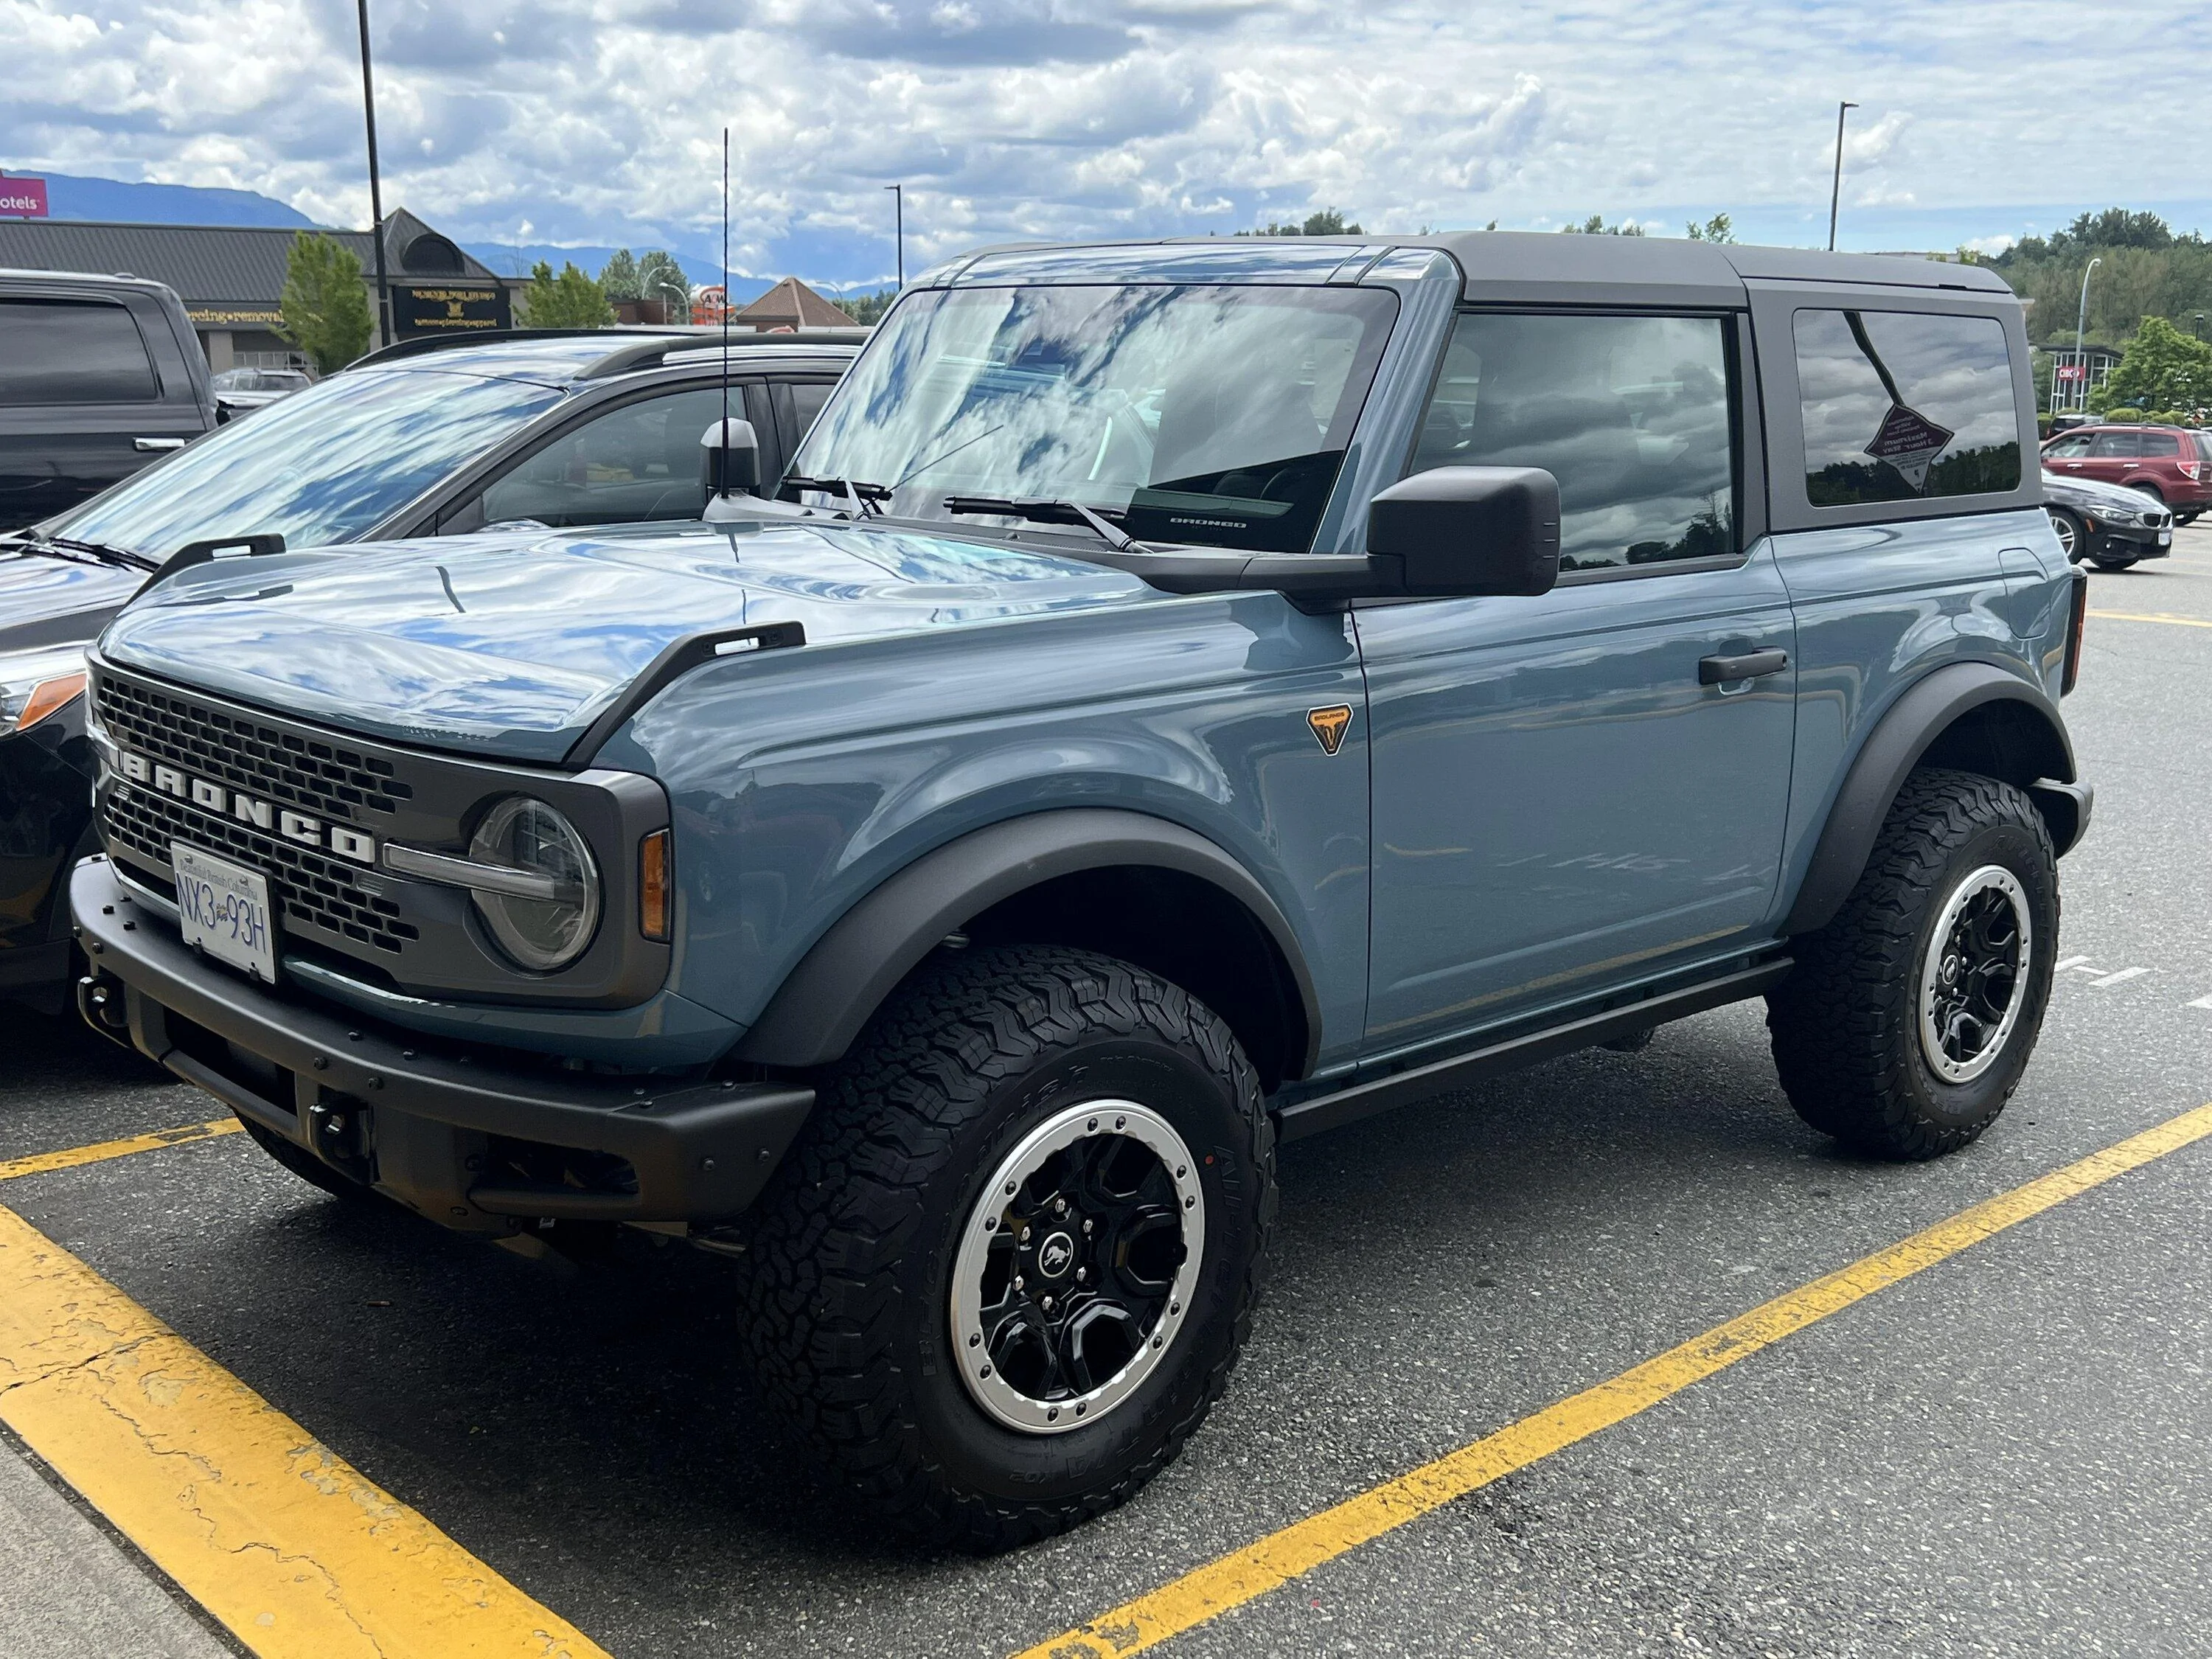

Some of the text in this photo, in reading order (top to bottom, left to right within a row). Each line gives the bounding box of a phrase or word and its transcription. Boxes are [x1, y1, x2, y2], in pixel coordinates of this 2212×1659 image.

[0, 195, 38, 209] otels
[1169, 517, 1247, 529] BRONCO
[122, 751, 376, 863] BRONCO
[180, 859, 258, 900] Beautiful British Columbia
[175, 872, 267, 955] NX3 93H
